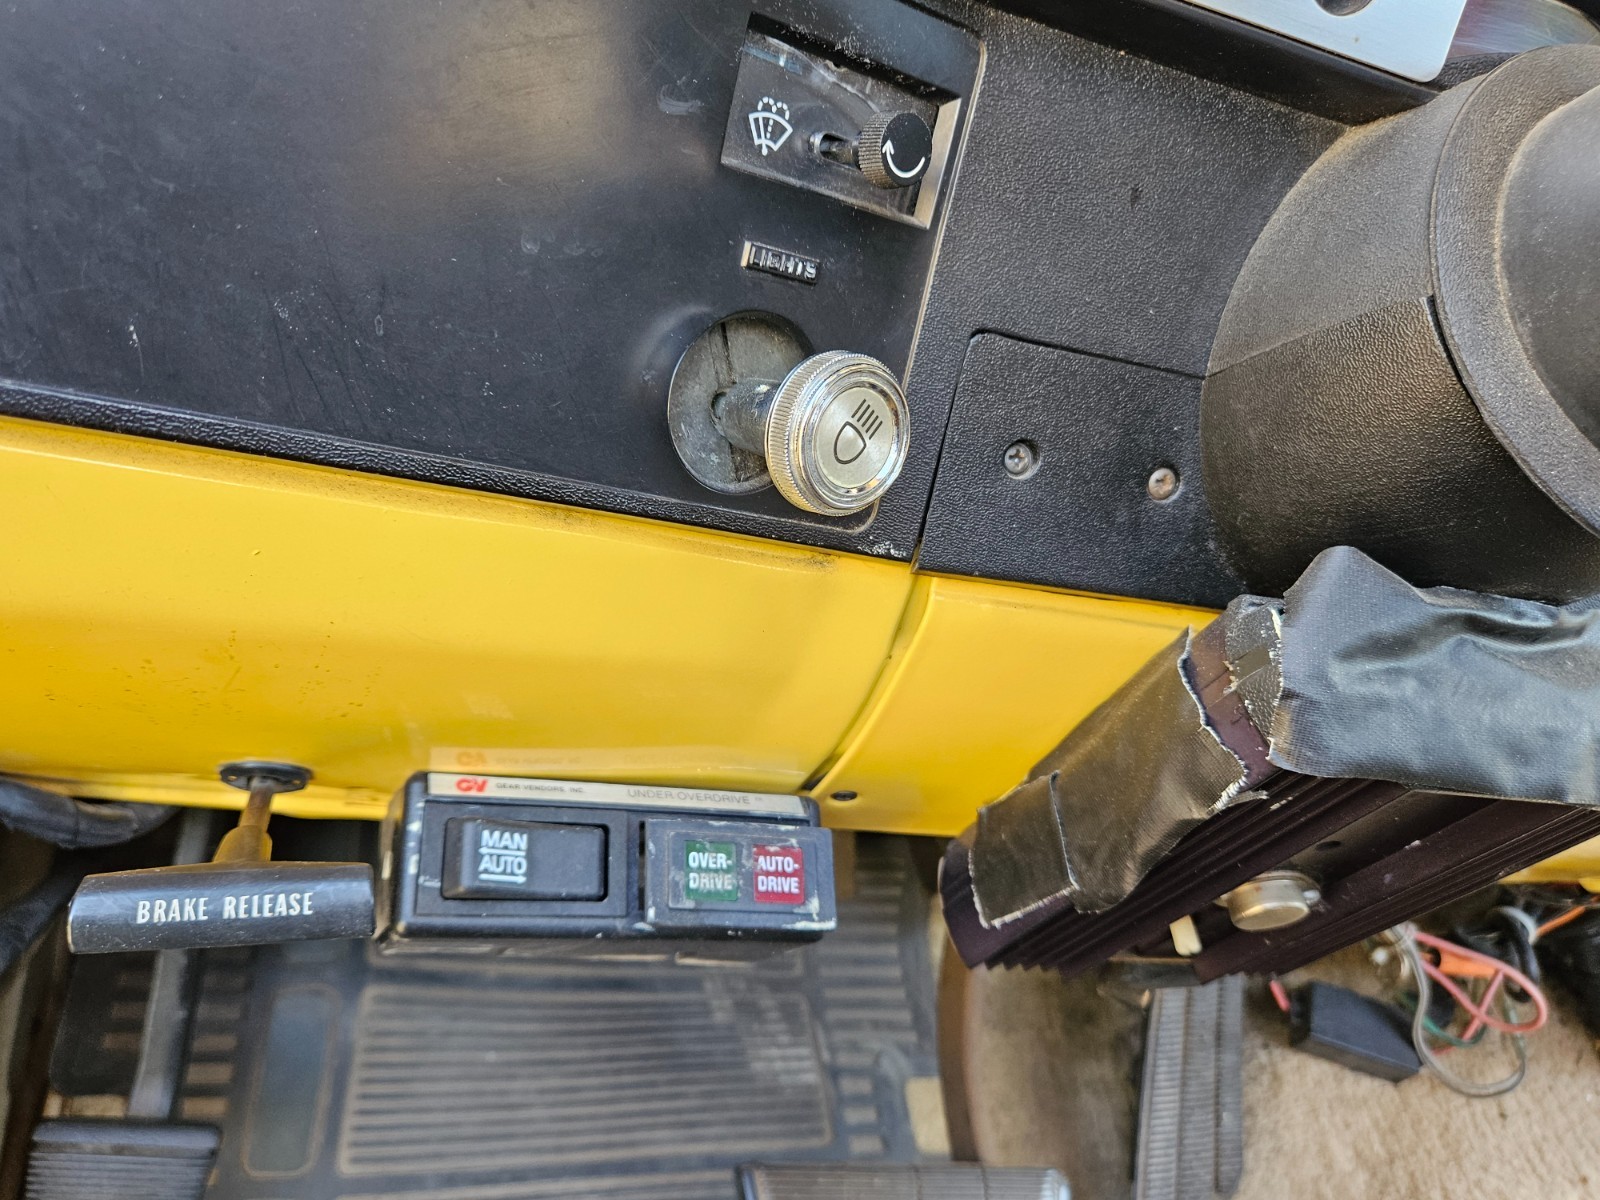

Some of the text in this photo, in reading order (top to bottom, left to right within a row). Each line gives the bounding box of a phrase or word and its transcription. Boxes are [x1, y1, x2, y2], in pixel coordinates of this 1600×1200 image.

[749, 244, 816, 279] LIGHTS
[455, 777, 488, 794] GV
[495, 782, 521, 790] GEAR
[628, 788, 751, 805] UNDER OVERDRIVE
[480, 830, 528, 850] MAN
[479, 855, 527, 874] AUTO
[688, 851, 733, 871] OVER-
[757, 855, 801, 873] AUTO-
[689, 872, 733, 891] DRIVE
[757, 875, 801, 893] DRIVE
[136, 892, 314, 924] BRAKE RELEASE
